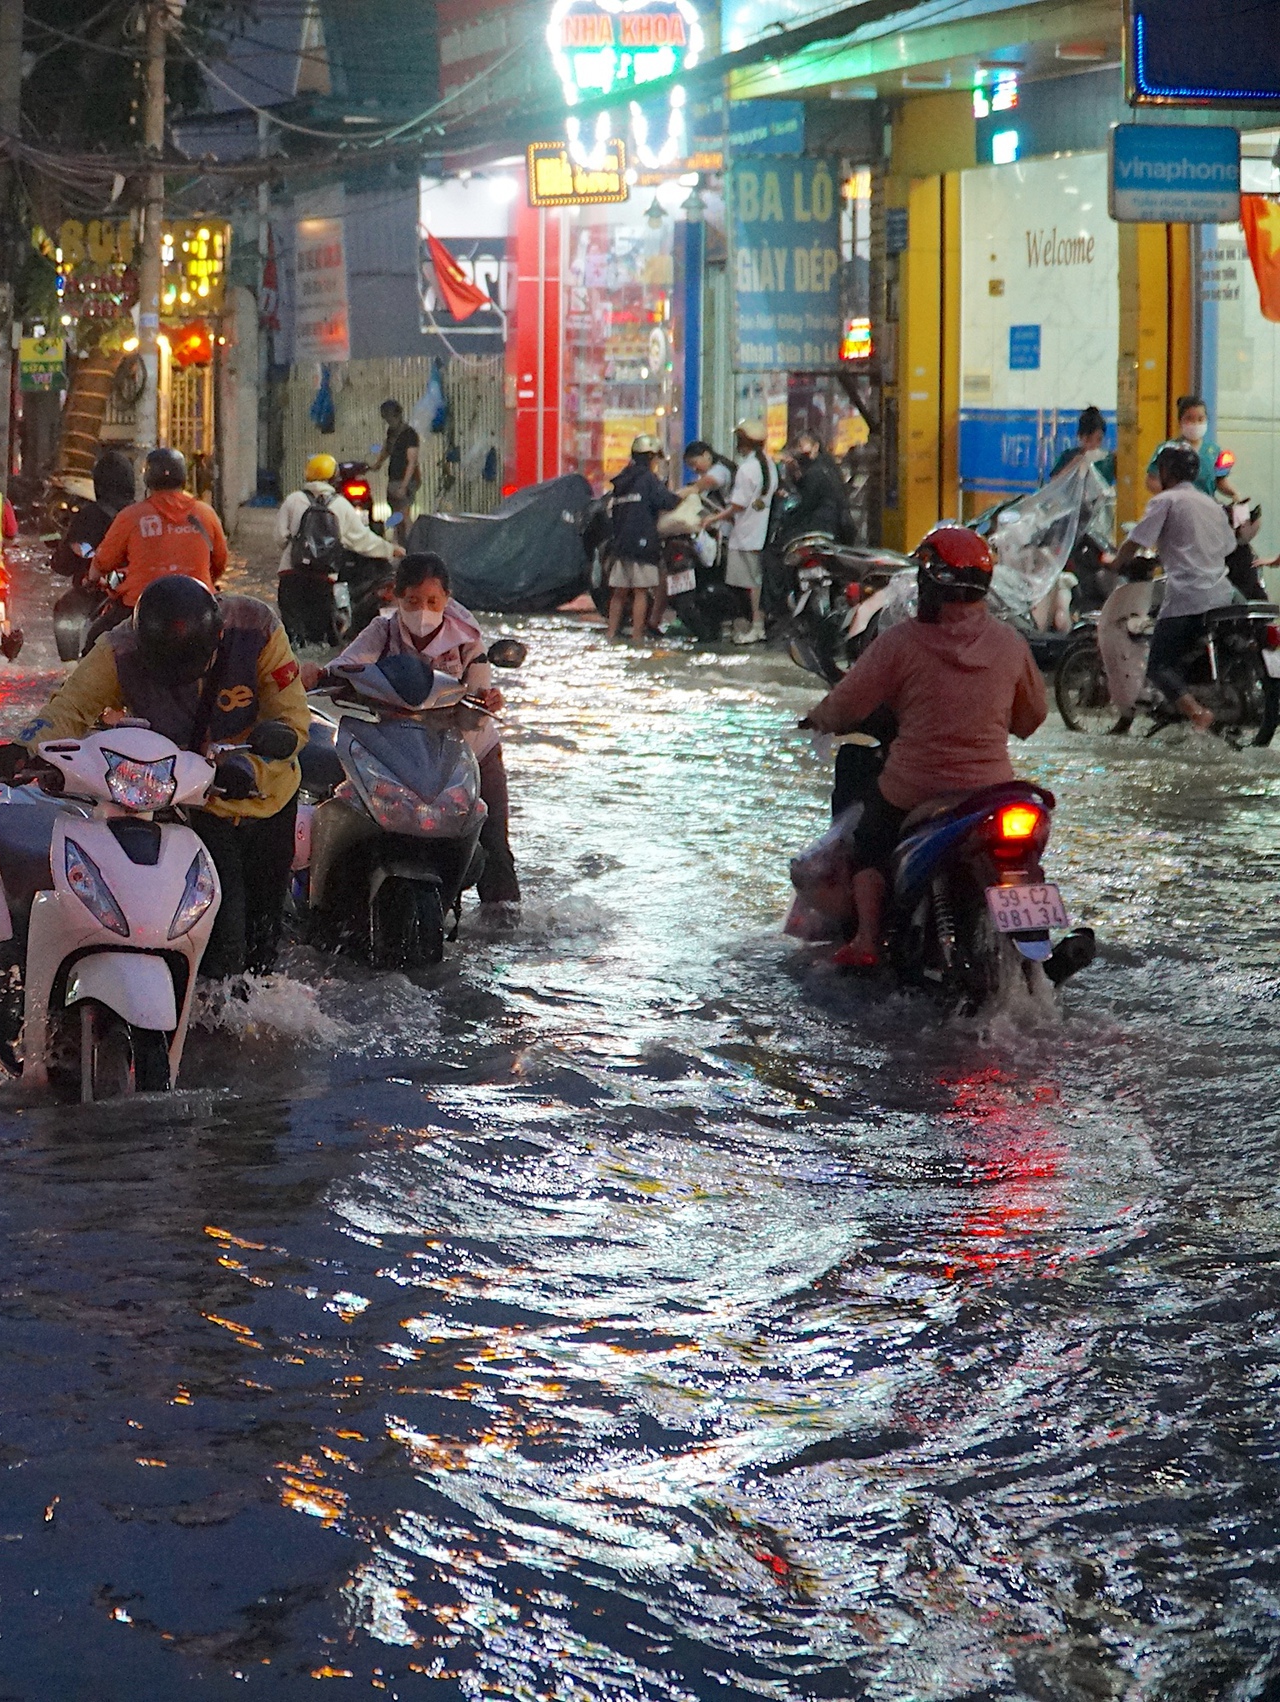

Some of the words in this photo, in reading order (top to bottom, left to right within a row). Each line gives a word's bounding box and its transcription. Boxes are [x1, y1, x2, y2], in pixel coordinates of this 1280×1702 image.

[562, 14, 614, 46] NHA
[621, 13, 686, 45] KHOA
[1120, 156, 1239, 182] vinaphone
[738, 171, 783, 222] BA
[794, 160, 833, 222] LÔ
[737, 238, 788, 292] GIÀY
[794, 238, 838, 292] DÉP
[1026, 225, 1095, 268] Welcome
[998, 887, 1051, 907] 59-C2
